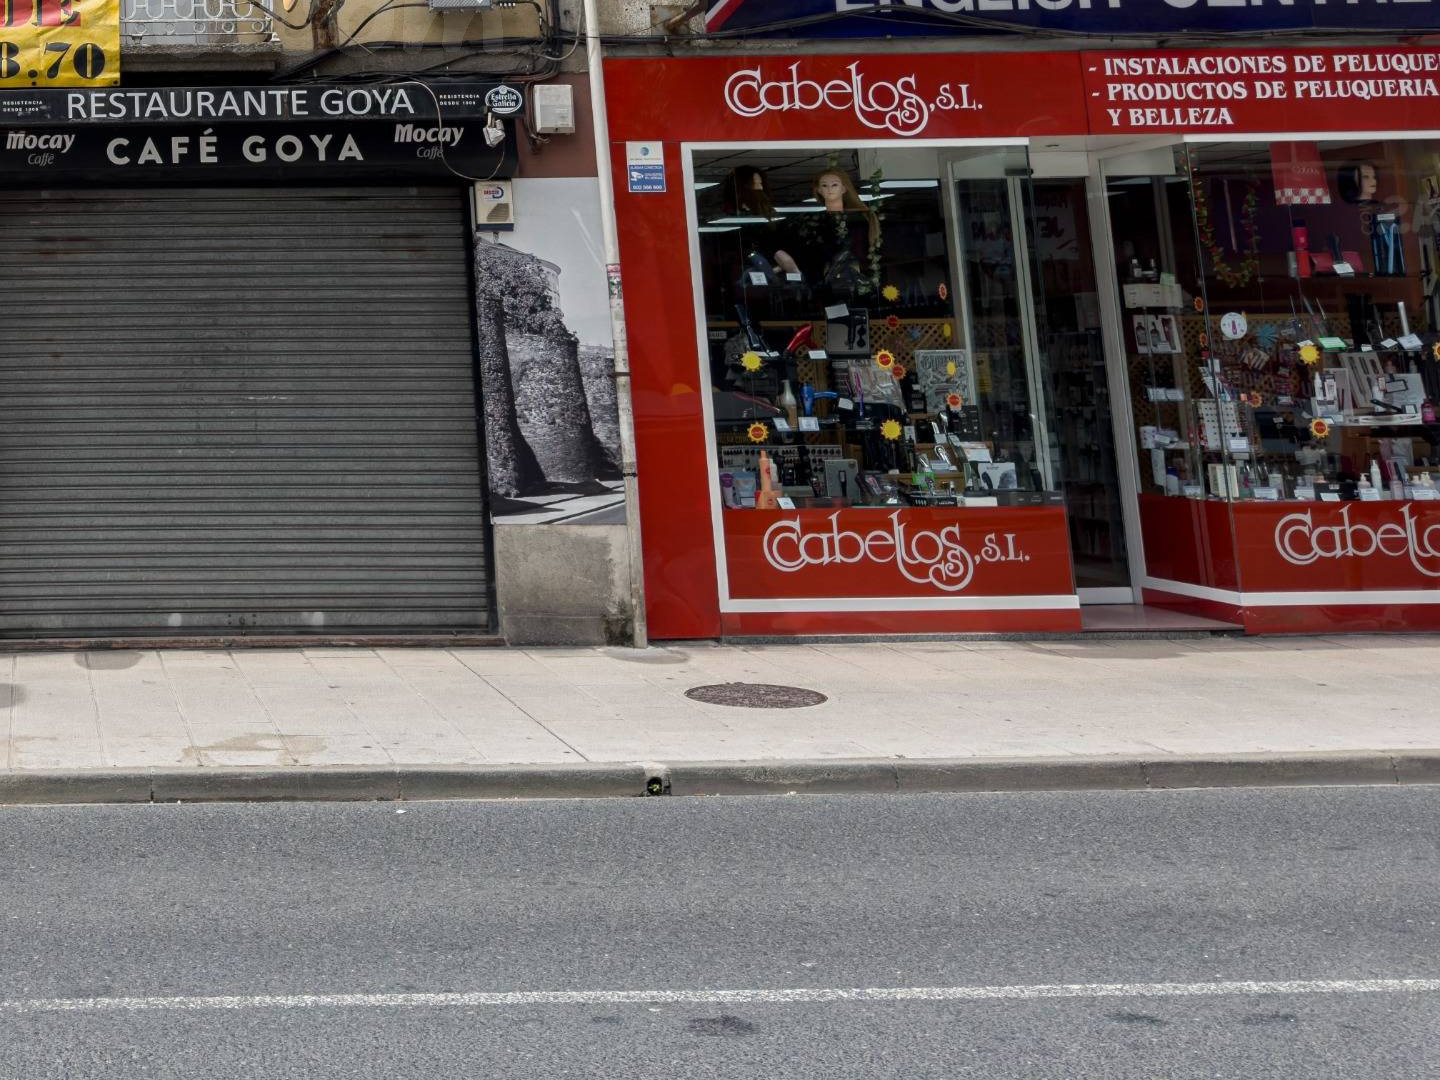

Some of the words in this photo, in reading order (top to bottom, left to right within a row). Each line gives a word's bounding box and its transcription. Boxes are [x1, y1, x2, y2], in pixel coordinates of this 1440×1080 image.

[1103, 56, 1287, 76] INSTALACIONES
[1293, 55, 1326, 73] DE
[1332, 53, 1440, 74] PELUQUE
[1107, 82, 1248, 101] PRODUCTOS
[1254, 81, 1287, 100] DE
[1294, 79, 1439, 101] PELUQUERIA
[67, 90, 309, 119] RESTAURANTE
[320, 88, 415, 115] GOYA
[1107, 108, 1122, 126] Y
[1128, 107, 1234, 126] BELLEZA
[6, 130, 75, 154] Mocay
[106, 128, 218, 166] CAFÉ
[242, 134, 364, 162] GOYA
[394, 123, 464, 147] Mocay
